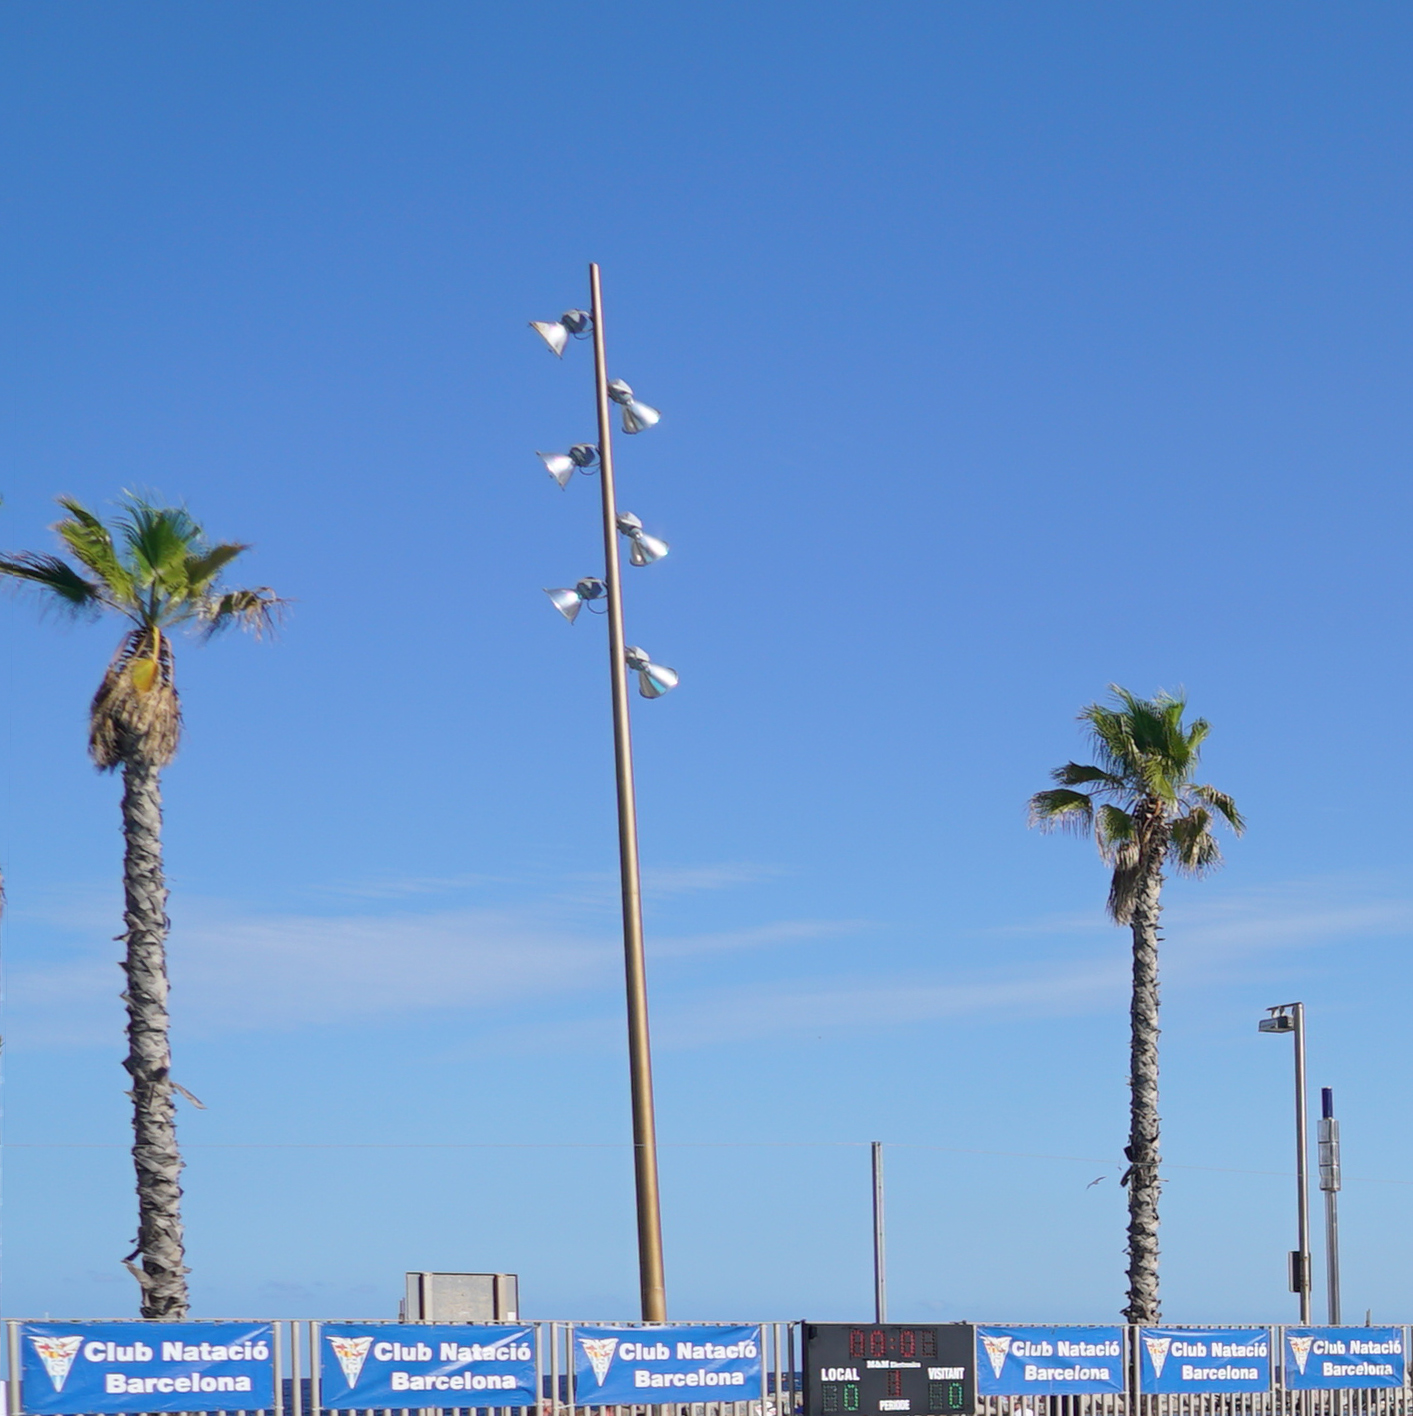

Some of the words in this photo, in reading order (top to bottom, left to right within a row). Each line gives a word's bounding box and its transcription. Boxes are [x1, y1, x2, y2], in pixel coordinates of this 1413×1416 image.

[83, 1339, 153, 1363] Club
[162, 1339, 270, 1362] Natació
[374, 1342, 433, 1361] Club
[439, 1340, 532, 1362] Natació
[618, 1340, 670, 1361] Club
[676, 1339, 758, 1360] Natació
[1011, 1338, 1054, 1358] Club
[1057, 1338, 1121, 1358] Natació
[1170, 1340, 1207, 1357] Club
[1211, 1339, 1268, 1357] Natació
[1312, 1339, 1346, 1355] Club
[1349, 1338, 1402, 1355] Natació
[634, 1367, 746, 1388] Barcelona
[821, 1368, 860, 1381] LOCAL
[928, 1367, 965, 1380] VISITANT
[1024, 1363, 1111, 1381] Barcelona
[1182, 1364, 1258, 1380] Barcelona
[1322, 1361, 1394, 1376] Barcelona
[105, 1372, 251, 1394] Barcelona
[391, 1369, 516, 1391] Barcelona
